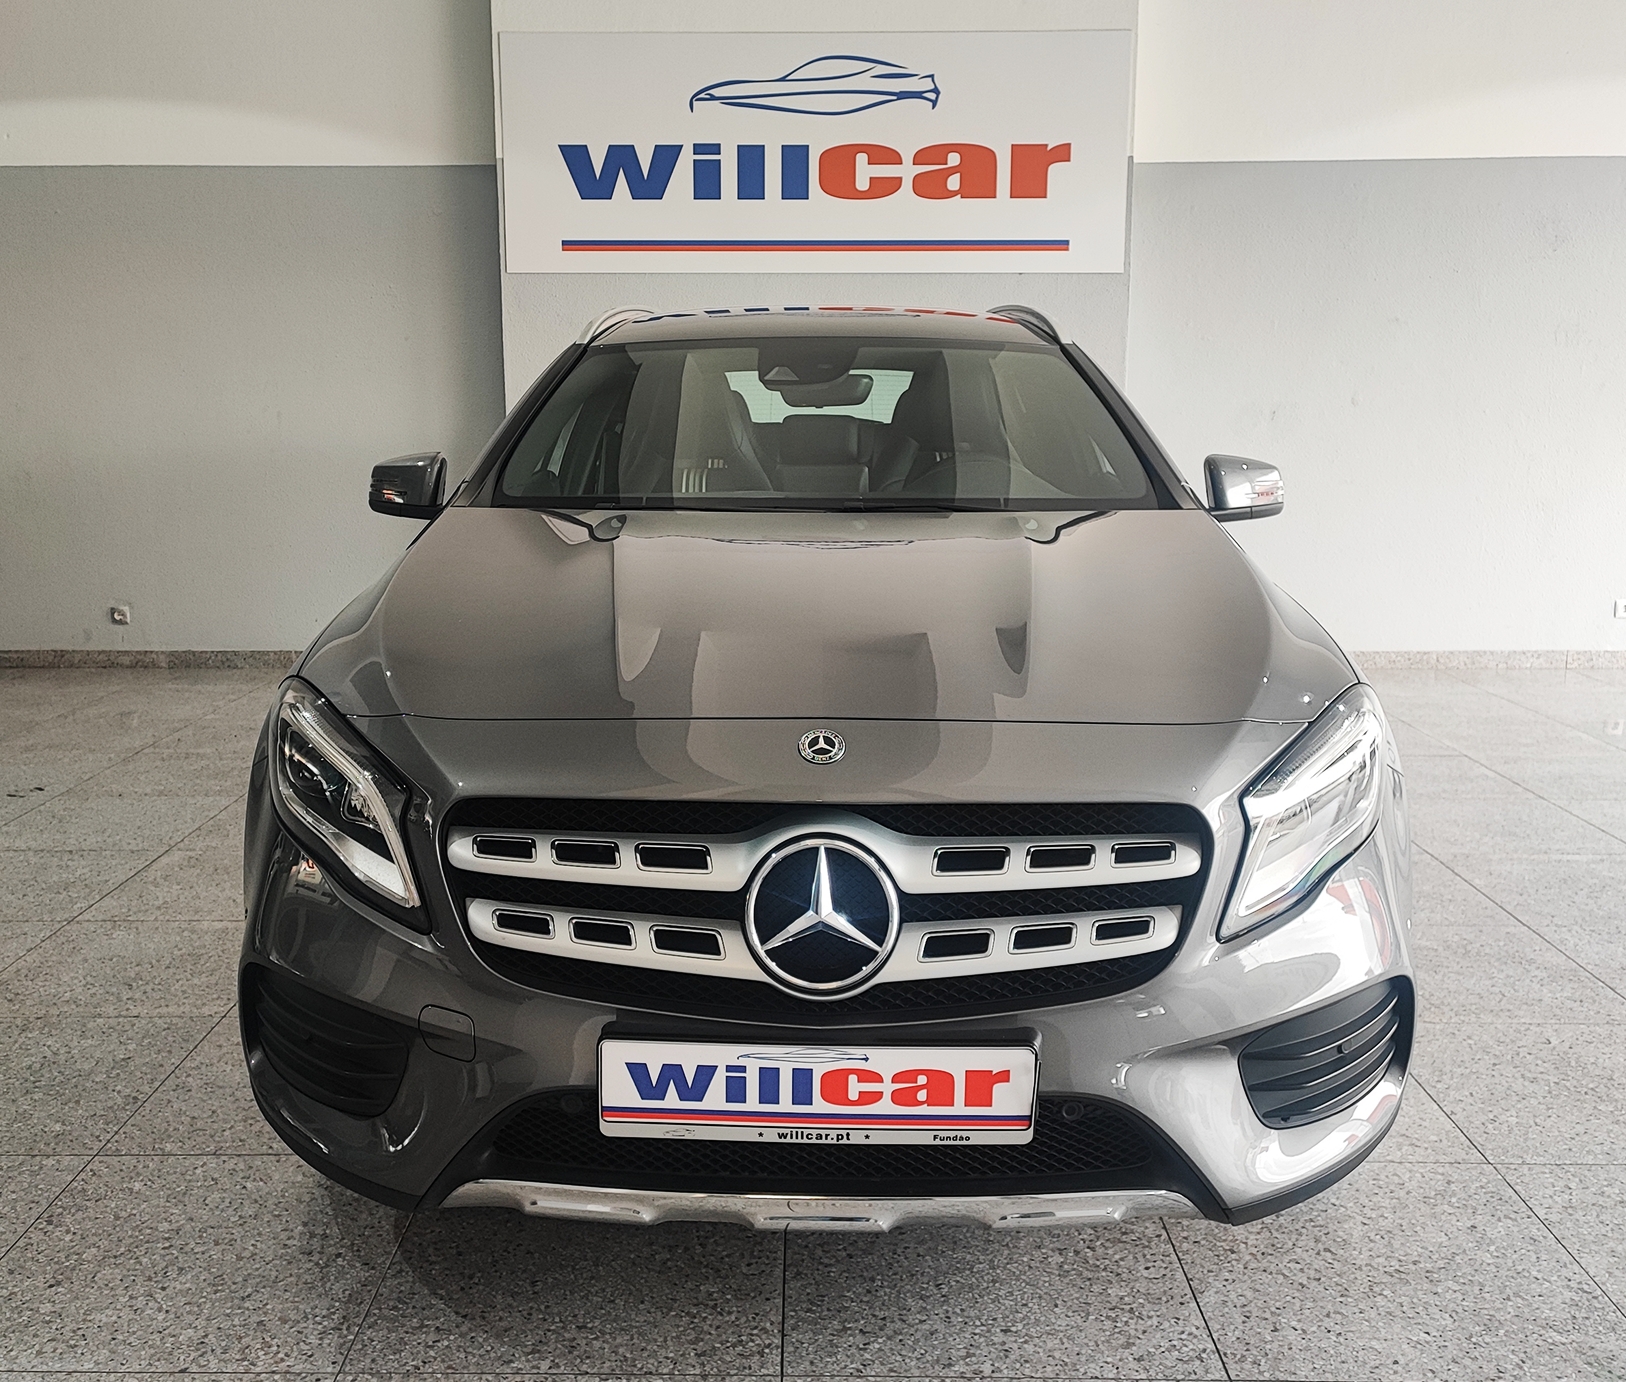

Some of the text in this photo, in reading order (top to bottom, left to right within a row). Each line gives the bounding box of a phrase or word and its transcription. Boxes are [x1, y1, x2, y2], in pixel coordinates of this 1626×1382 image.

[558, 143, 1072, 201] willcar
[624, 1062, 1012, 1108] willcar
[776, 1130, 851, 1143] willcar.pt
